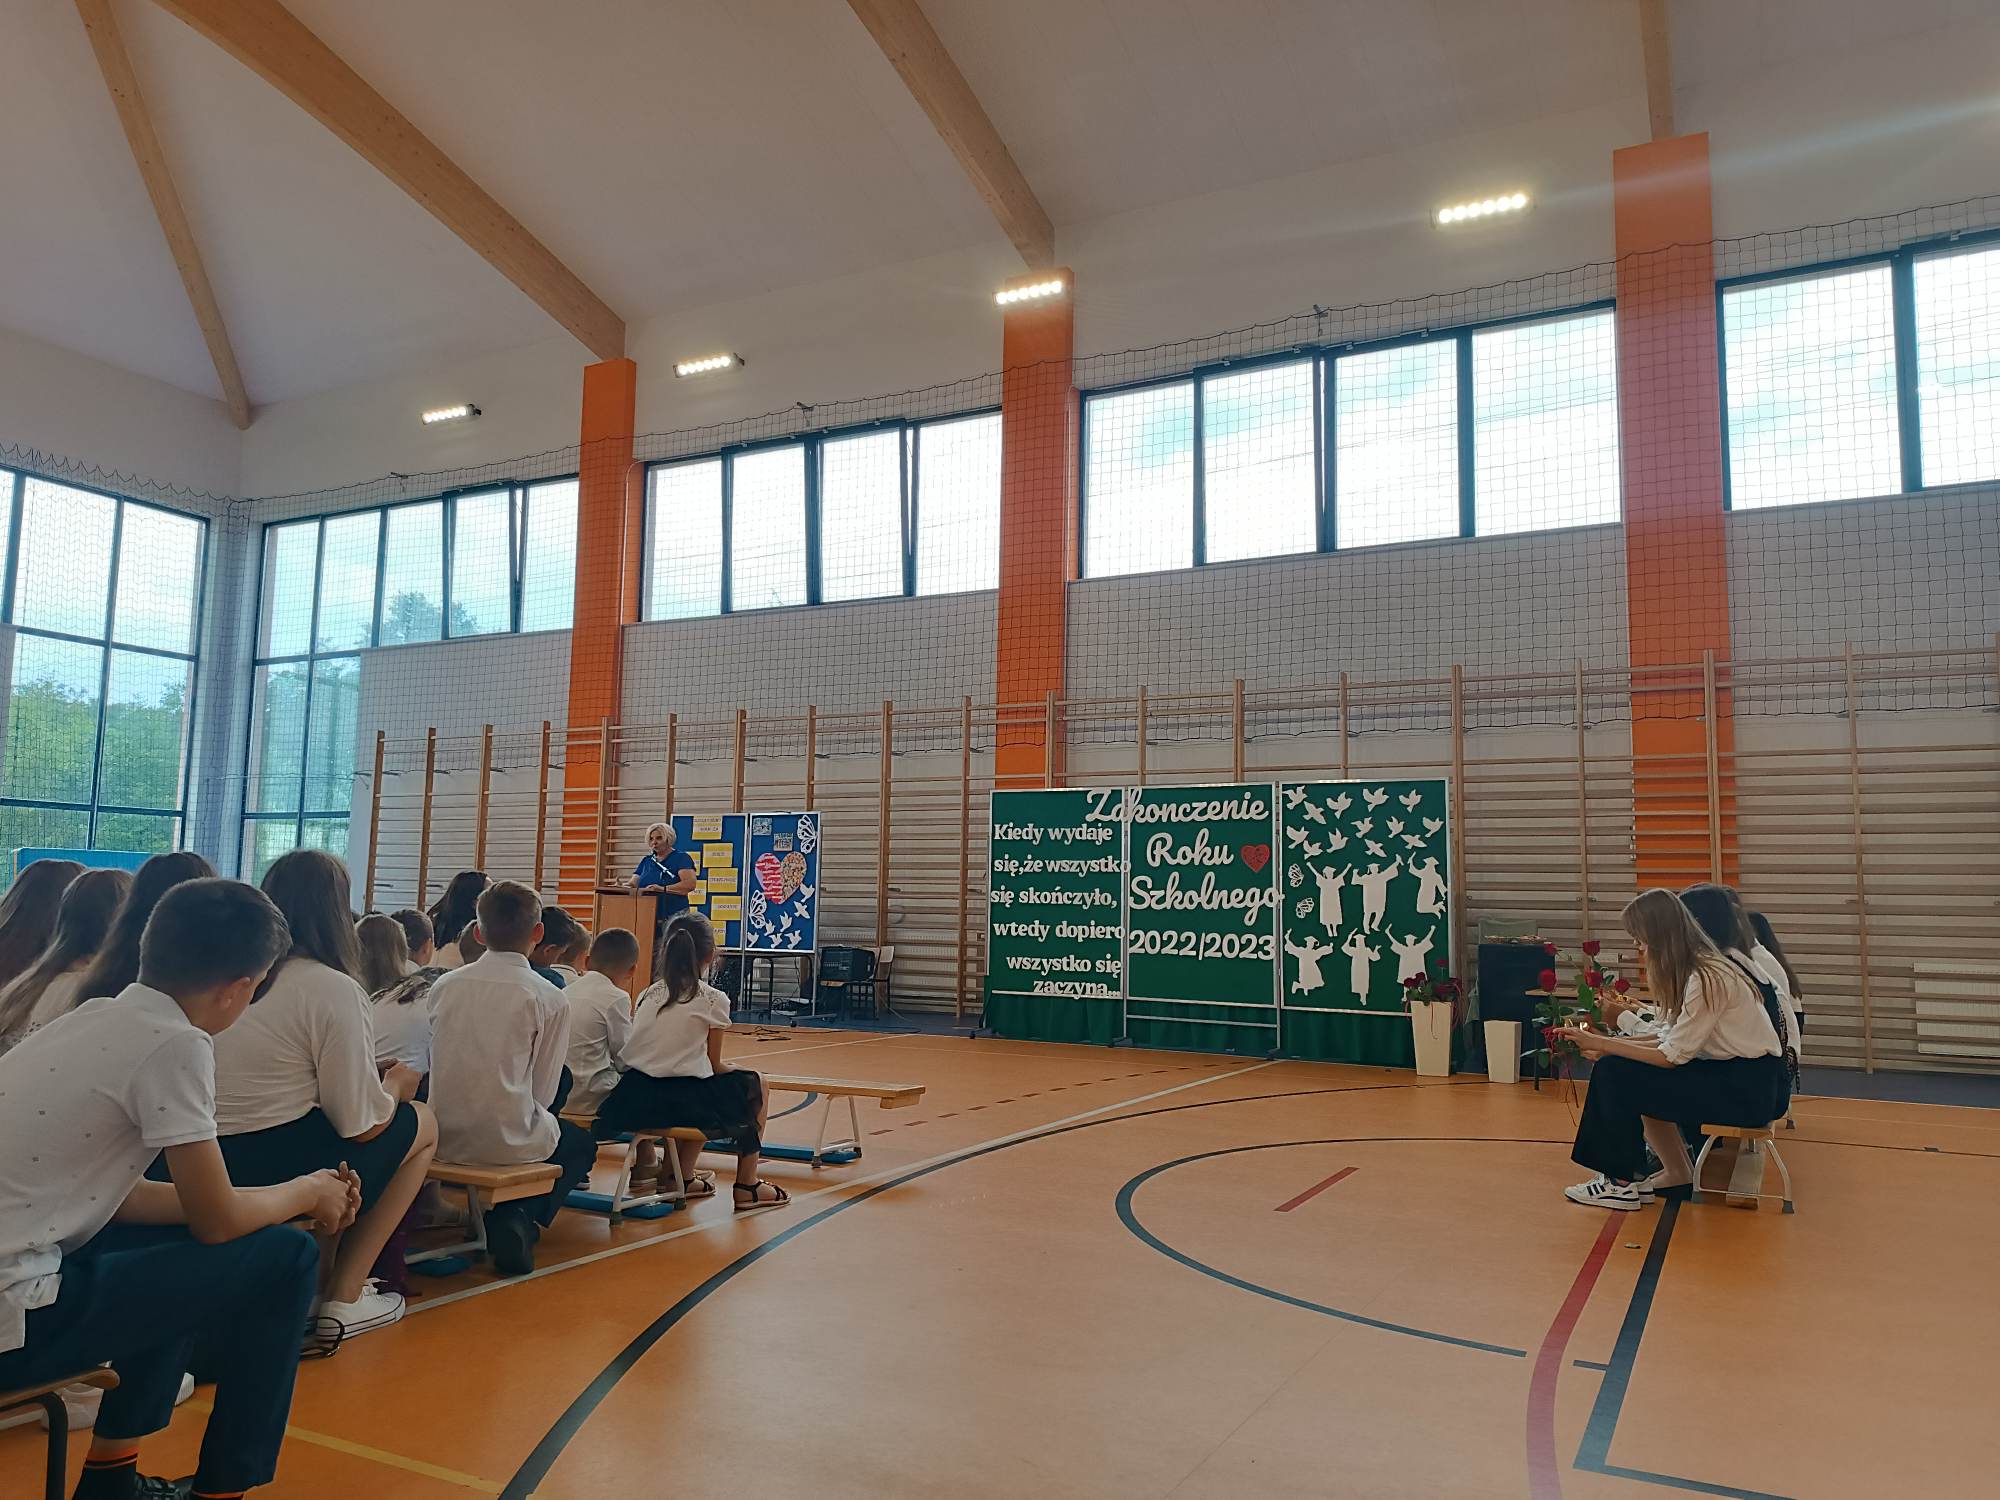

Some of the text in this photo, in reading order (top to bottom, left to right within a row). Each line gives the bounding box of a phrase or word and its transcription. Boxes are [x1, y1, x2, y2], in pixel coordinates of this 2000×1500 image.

[993, 822, 1113, 845] Kiedy wydaje
[1146, 827, 1235, 867] Roku
[1045, 855, 1131, 877] wszystko
[990, 885, 1117, 910] się skończyło,
[1128, 871, 1285, 926] Szkolnego
[993, 920, 1126, 942] wtedy dopiero
[1128, 929, 1277, 961] 2022/2023
[1006, 953, 1122, 978] wszystko się
